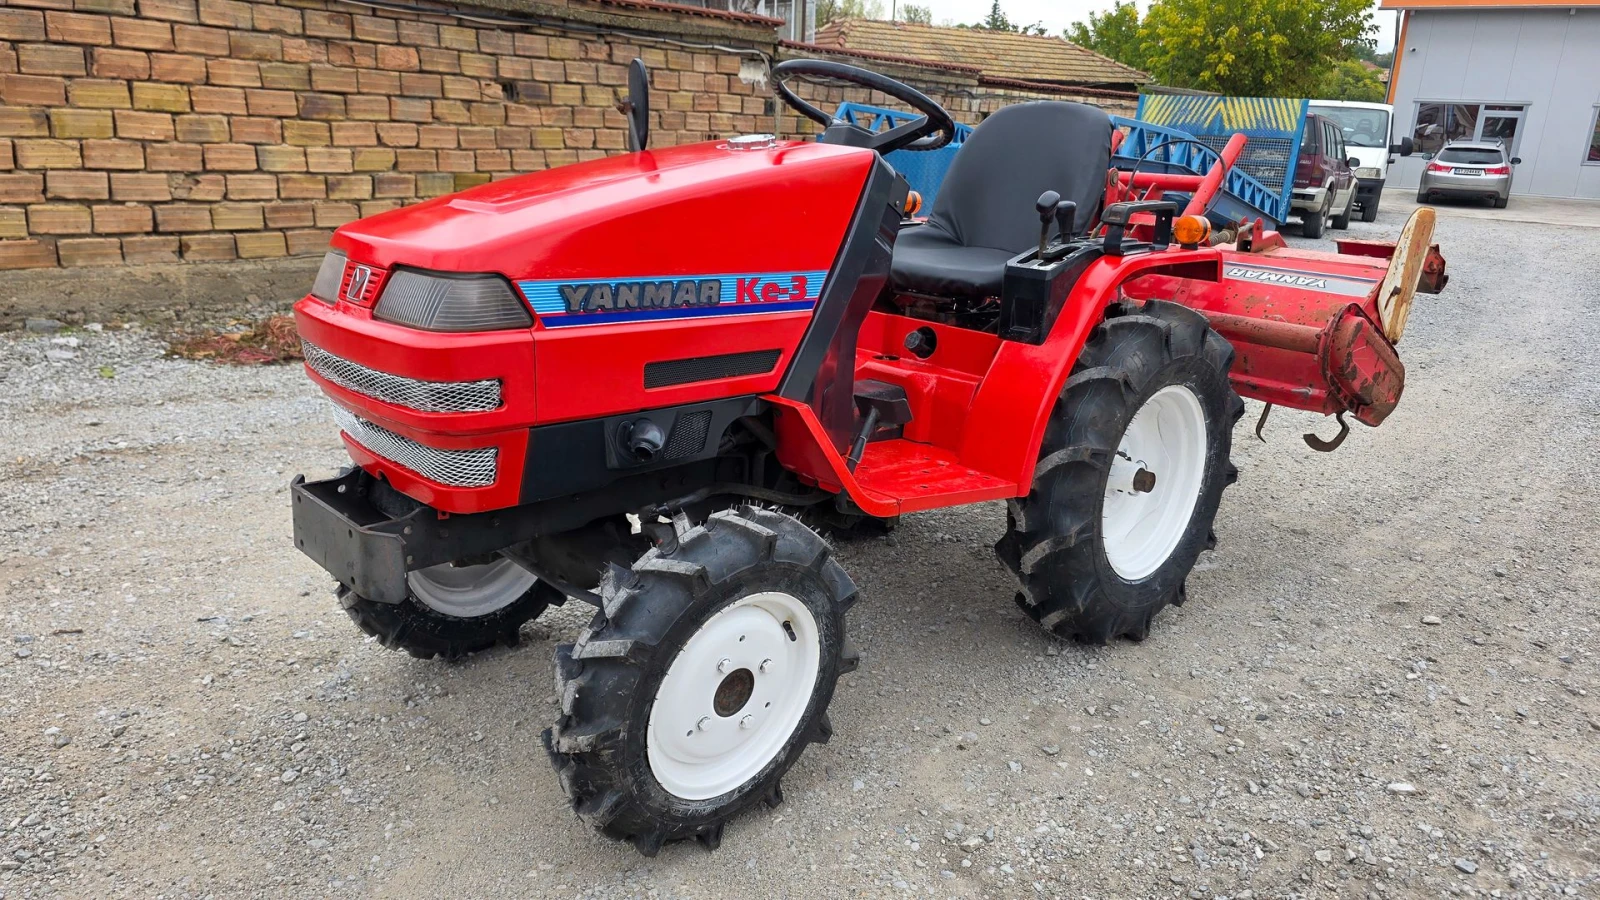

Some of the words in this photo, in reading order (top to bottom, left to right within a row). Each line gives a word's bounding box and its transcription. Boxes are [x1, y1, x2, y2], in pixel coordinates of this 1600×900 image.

[1227, 267, 1326, 289] YANMAR
[560, 279, 722, 313] YANMAR
[736, 276, 808, 303] Ke-3
